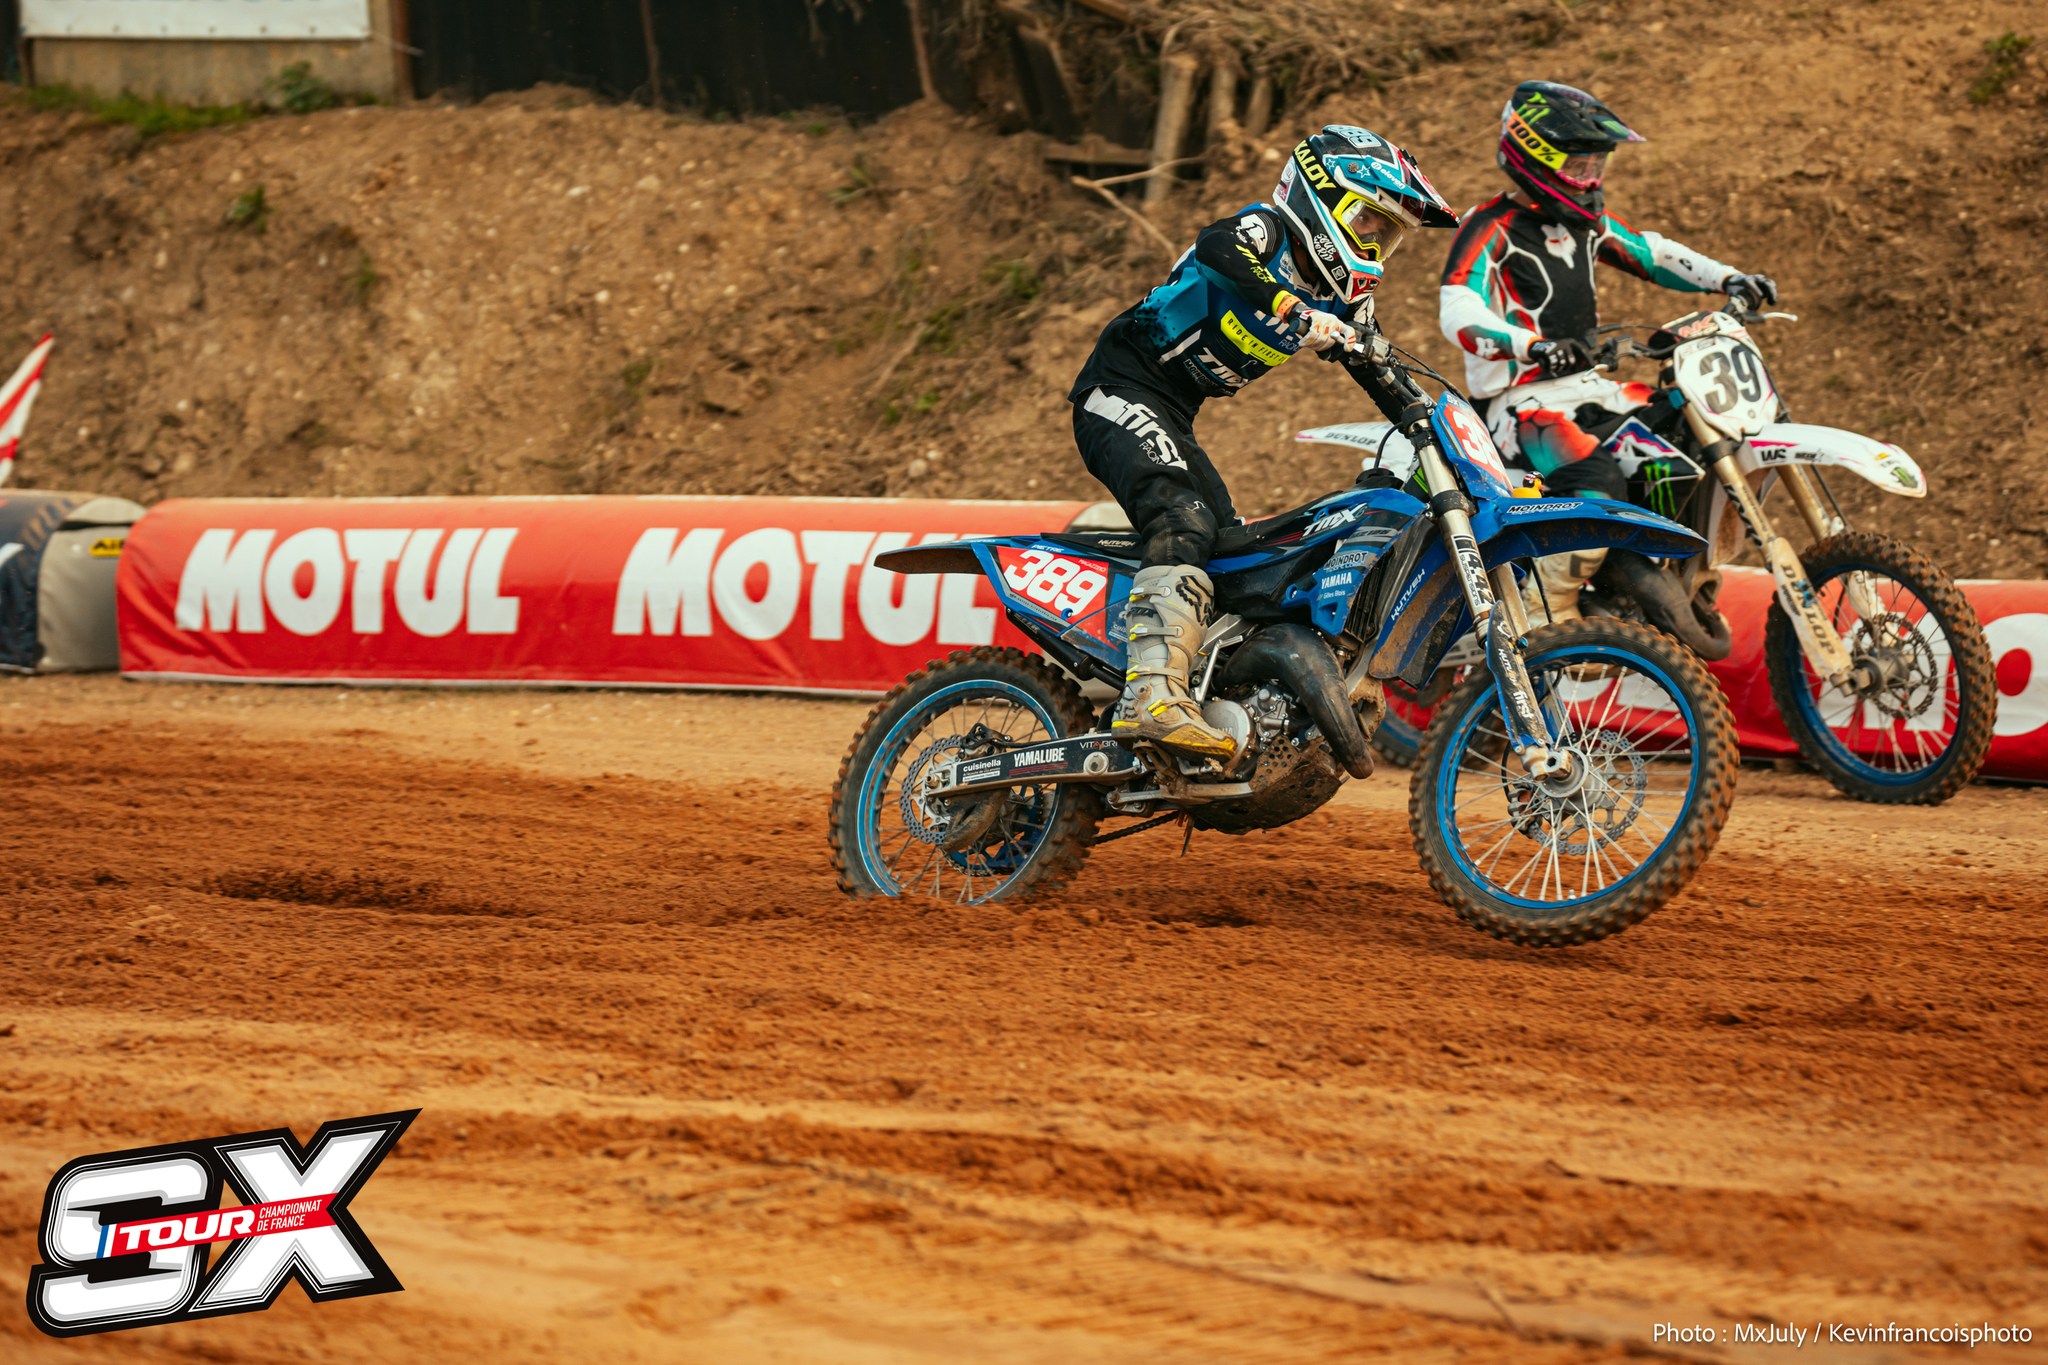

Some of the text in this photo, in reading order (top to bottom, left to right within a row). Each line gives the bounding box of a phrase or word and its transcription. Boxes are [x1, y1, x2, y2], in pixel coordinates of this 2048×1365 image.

[1510, 119, 1560, 162] 100%
[1227, 317, 1248, 341] RIDE
[1248, 340, 1259, 349] IN
[1260, 346, 1280, 361] FIRST
[1699, 345, 1762, 414] 39
[1324, 431, 1378, 446] DUNLOP
[1507, 502, 1584, 514] MOINDROT
[174, 527, 520, 637] MOTUL
[612, 528, 998, 647] MOTUL
[1004, 549, 1107, 616] 389
[1321, 571, 1353, 590] YAMAHA
[962, 759, 1002, 773] cuisinella
[1013, 748, 1066, 768] YAMALUBE
